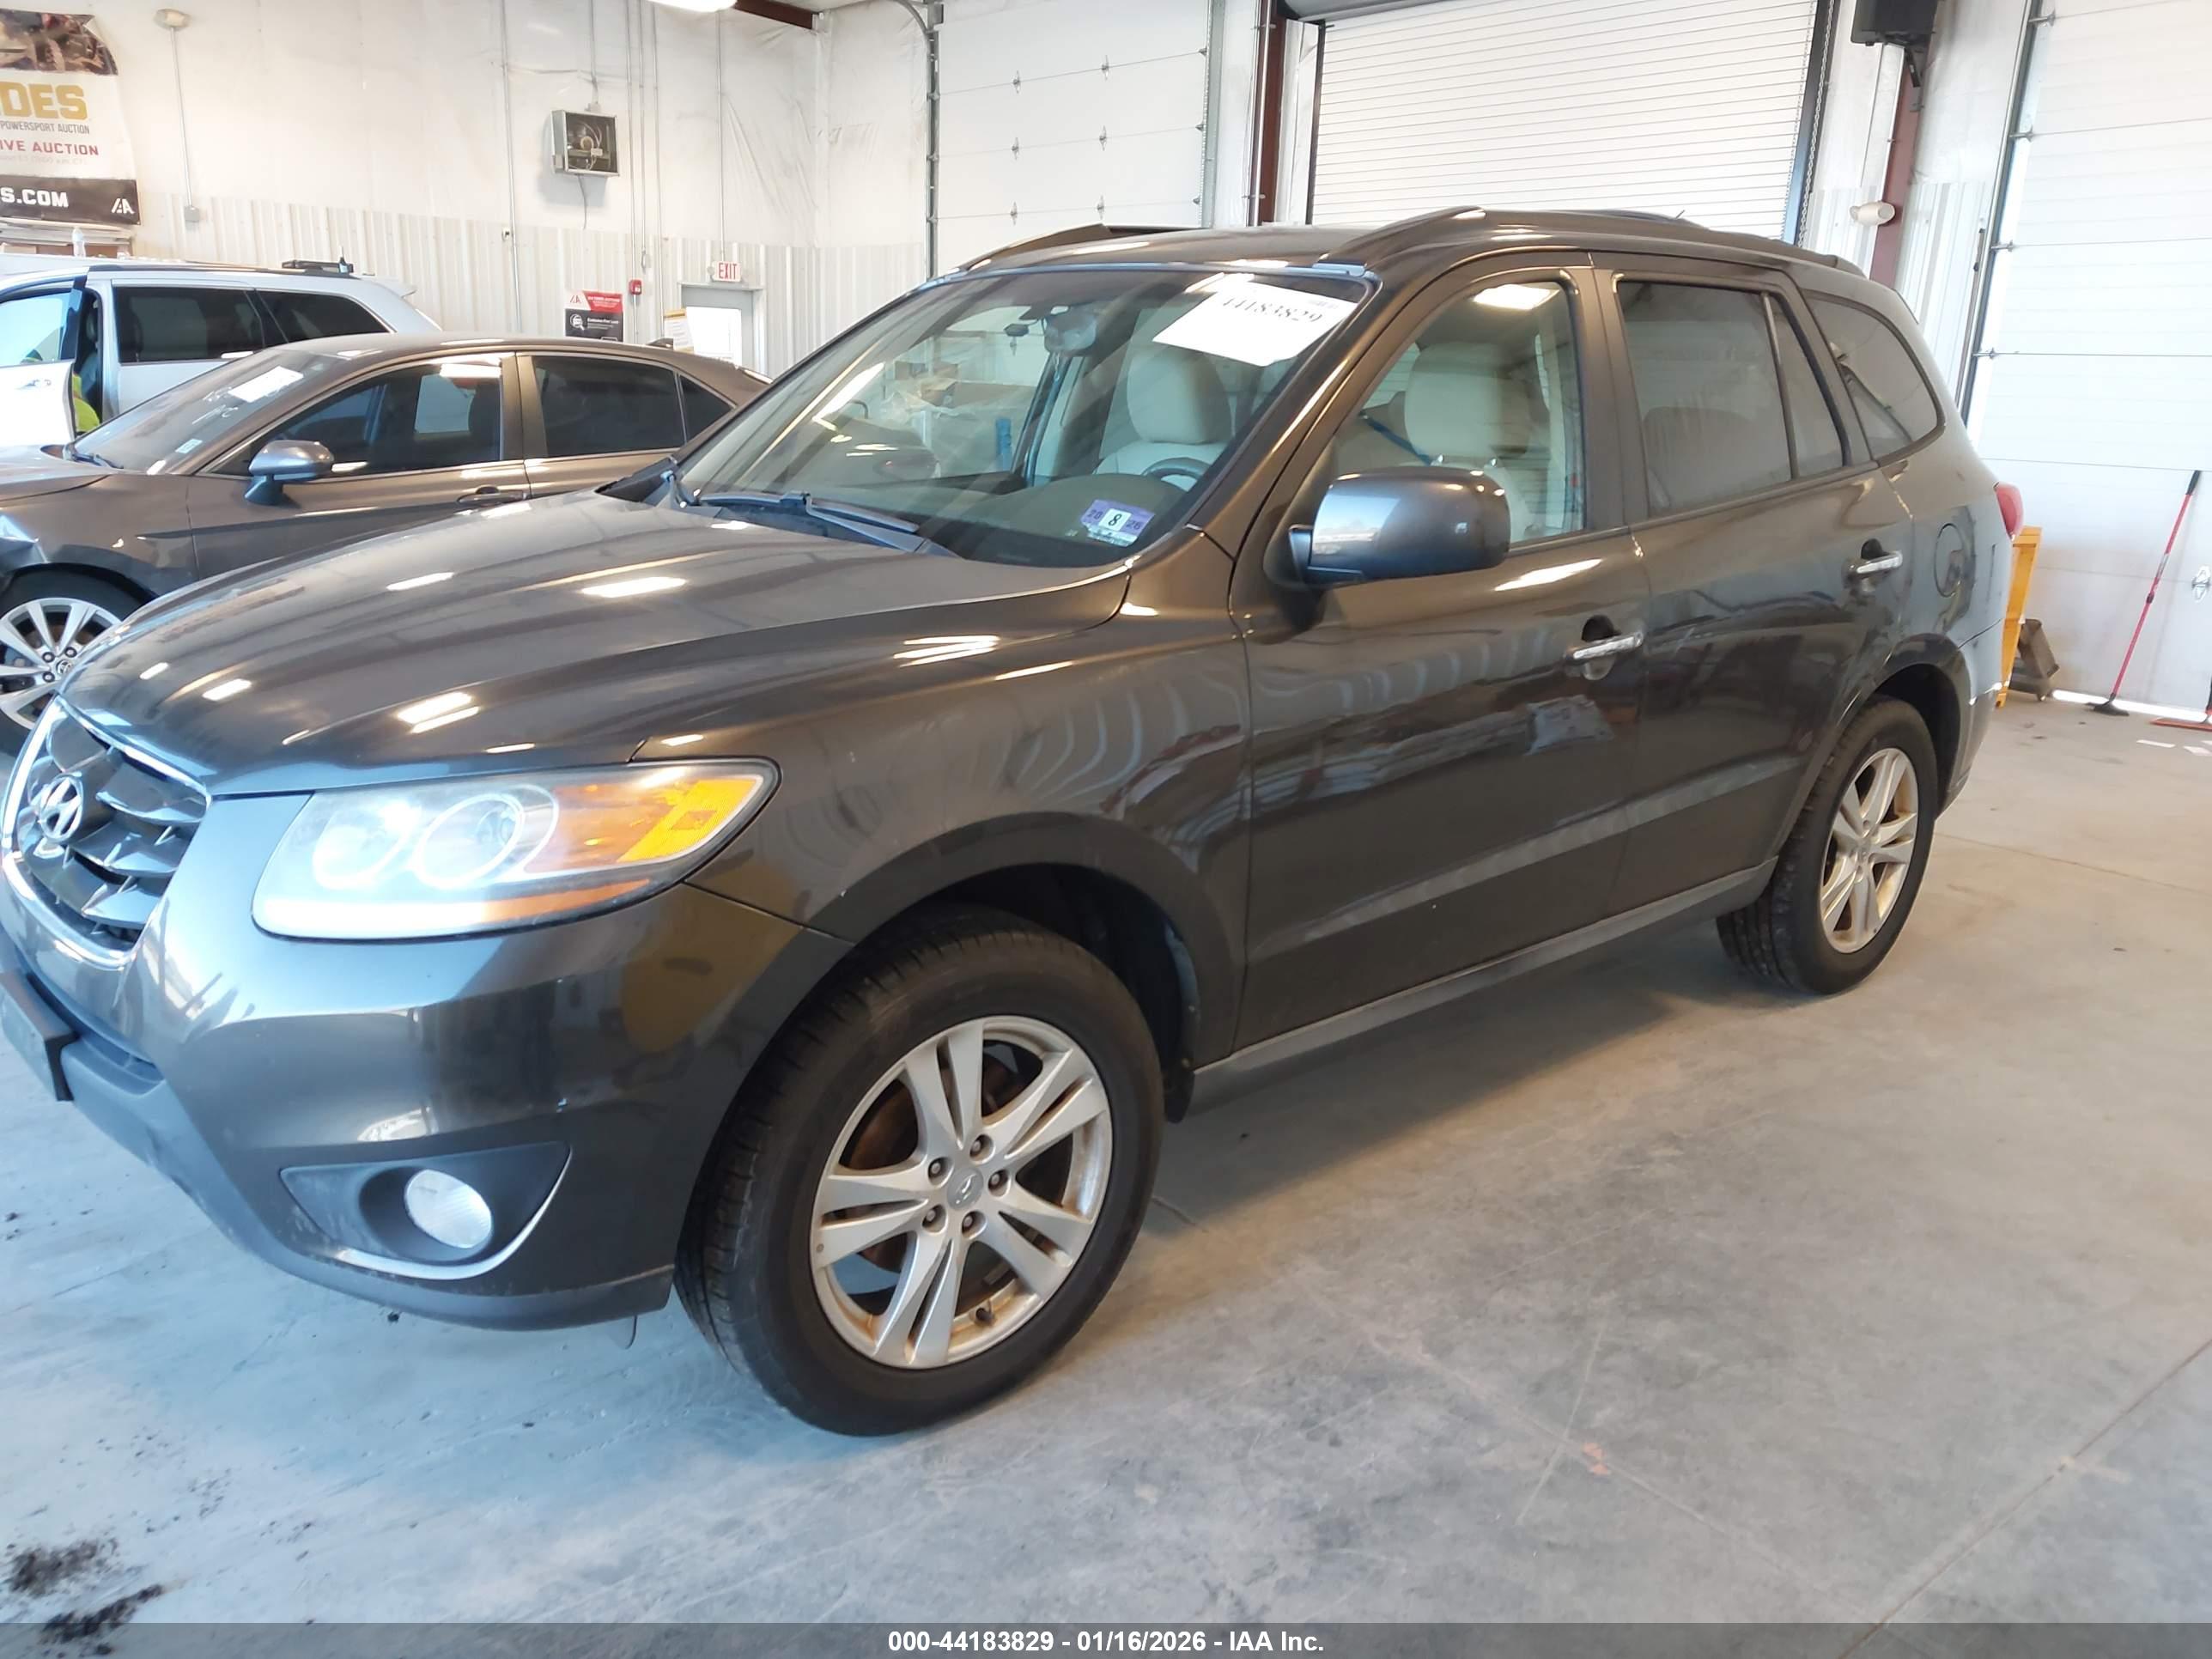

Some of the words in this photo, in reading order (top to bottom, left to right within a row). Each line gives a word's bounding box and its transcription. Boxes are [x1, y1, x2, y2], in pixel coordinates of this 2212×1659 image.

[58, 123, 90, 134] AUCTION
[33, 142, 99, 155] AUCTION
[718, 262, 738, 280] EXIT
[1108, 514, 1122, 526] 8
